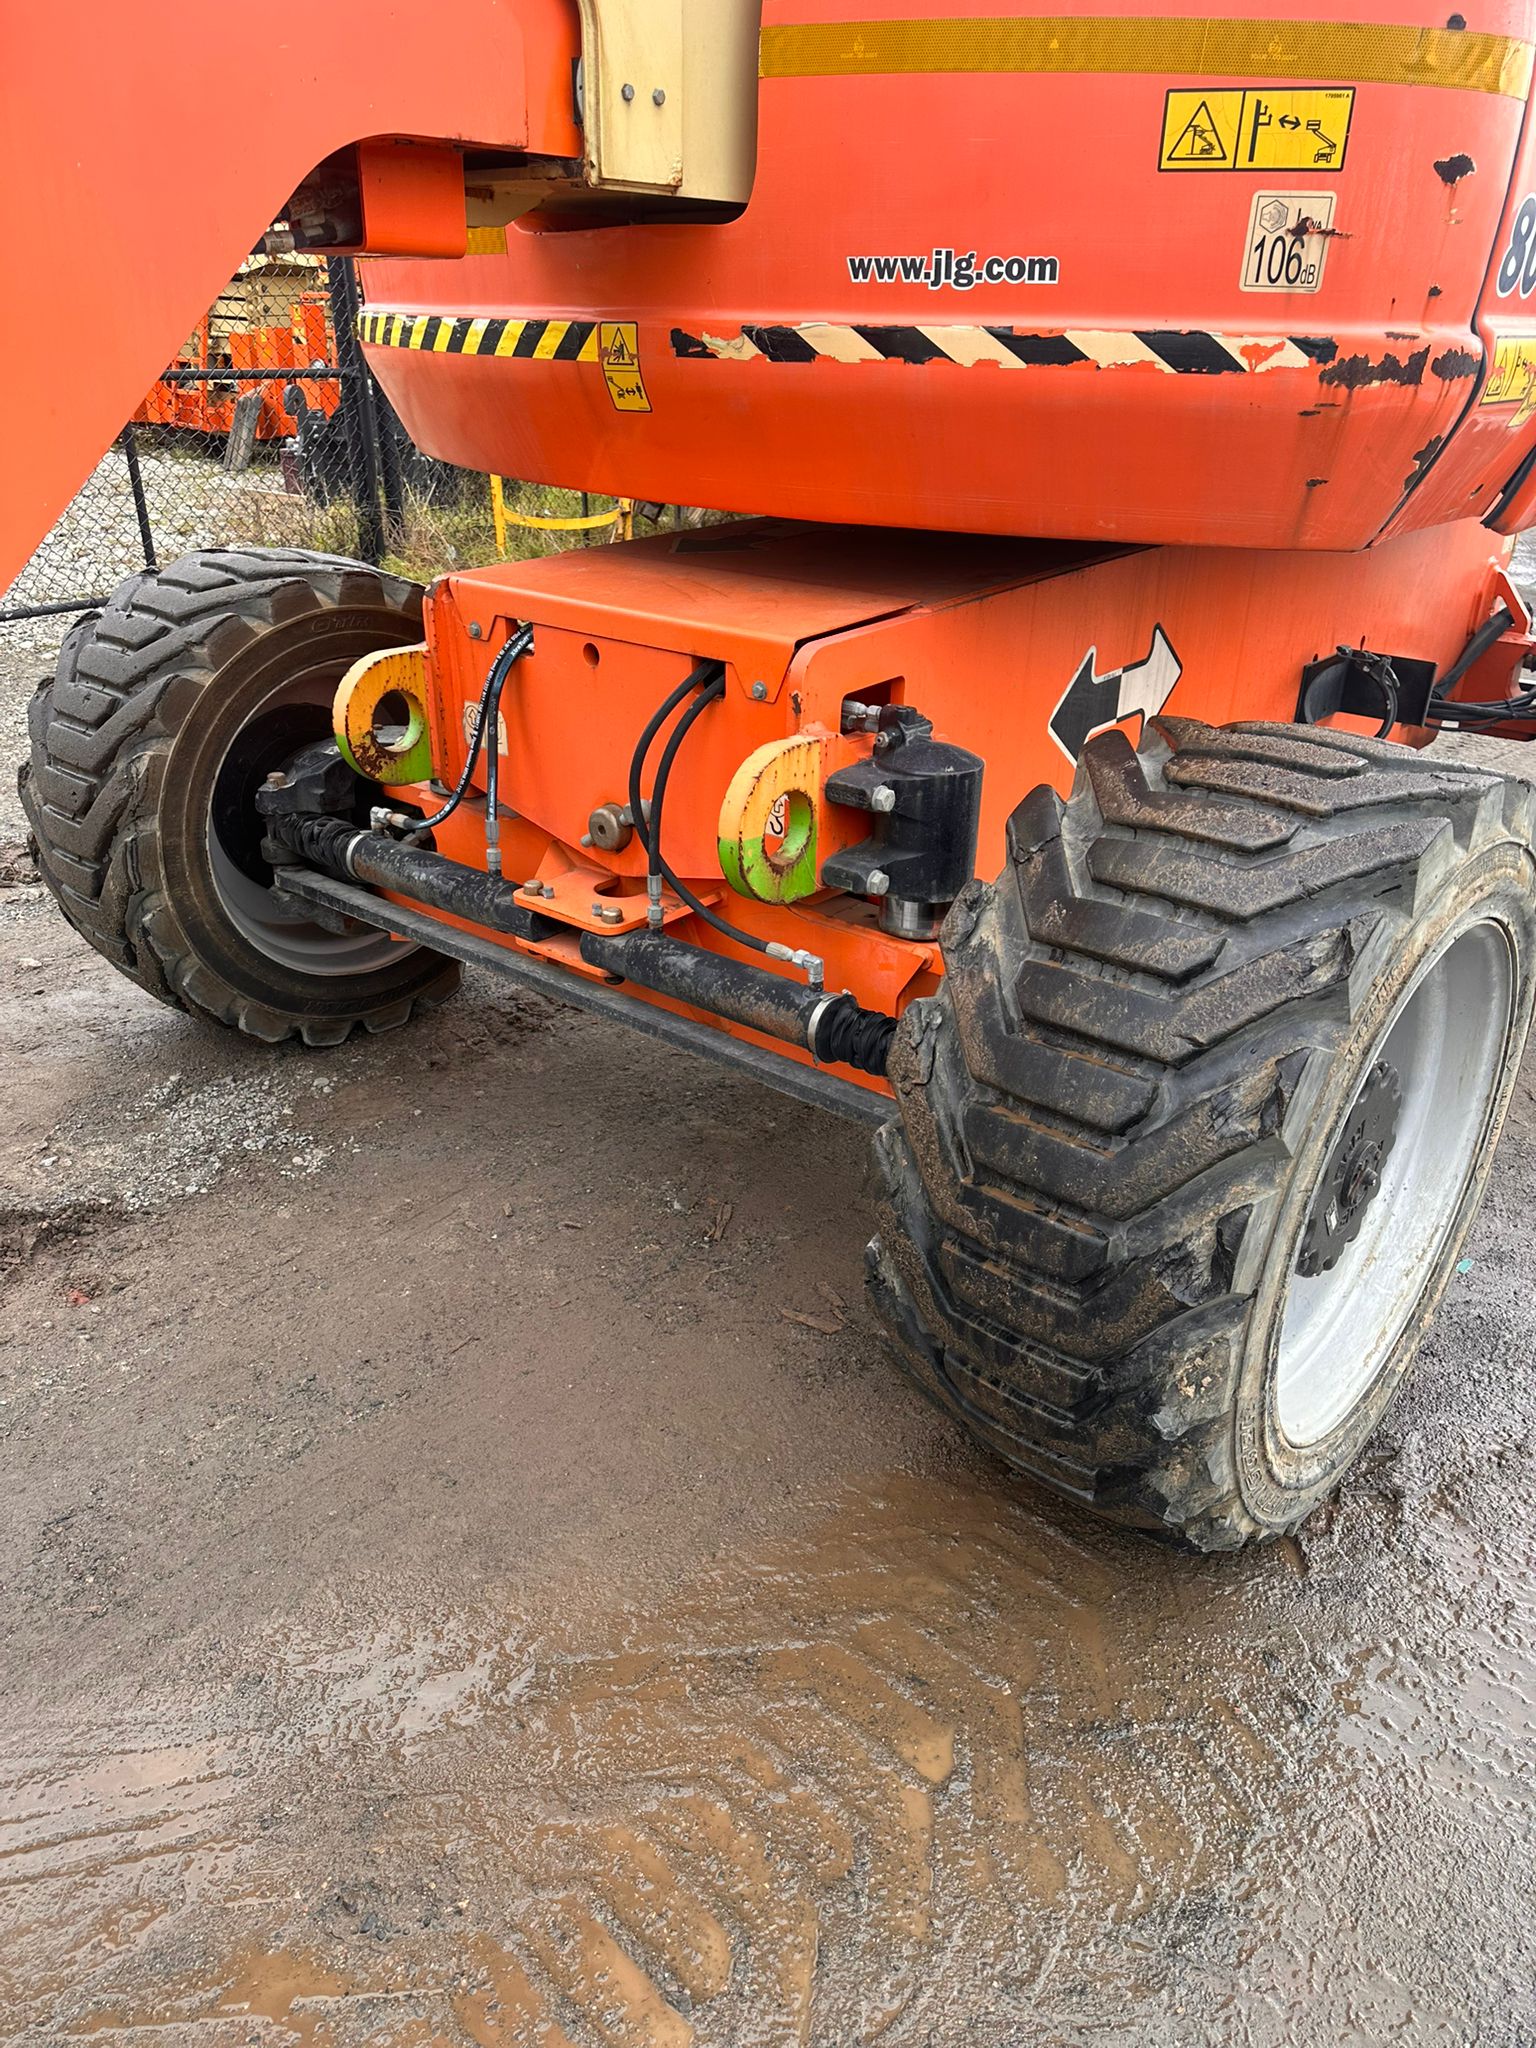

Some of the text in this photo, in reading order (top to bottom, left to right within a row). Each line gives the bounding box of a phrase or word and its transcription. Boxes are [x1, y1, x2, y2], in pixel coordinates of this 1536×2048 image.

[848, 249, 1058, 288] www.jlg.com
[1254, 235, 1316, 284] 106 dB
